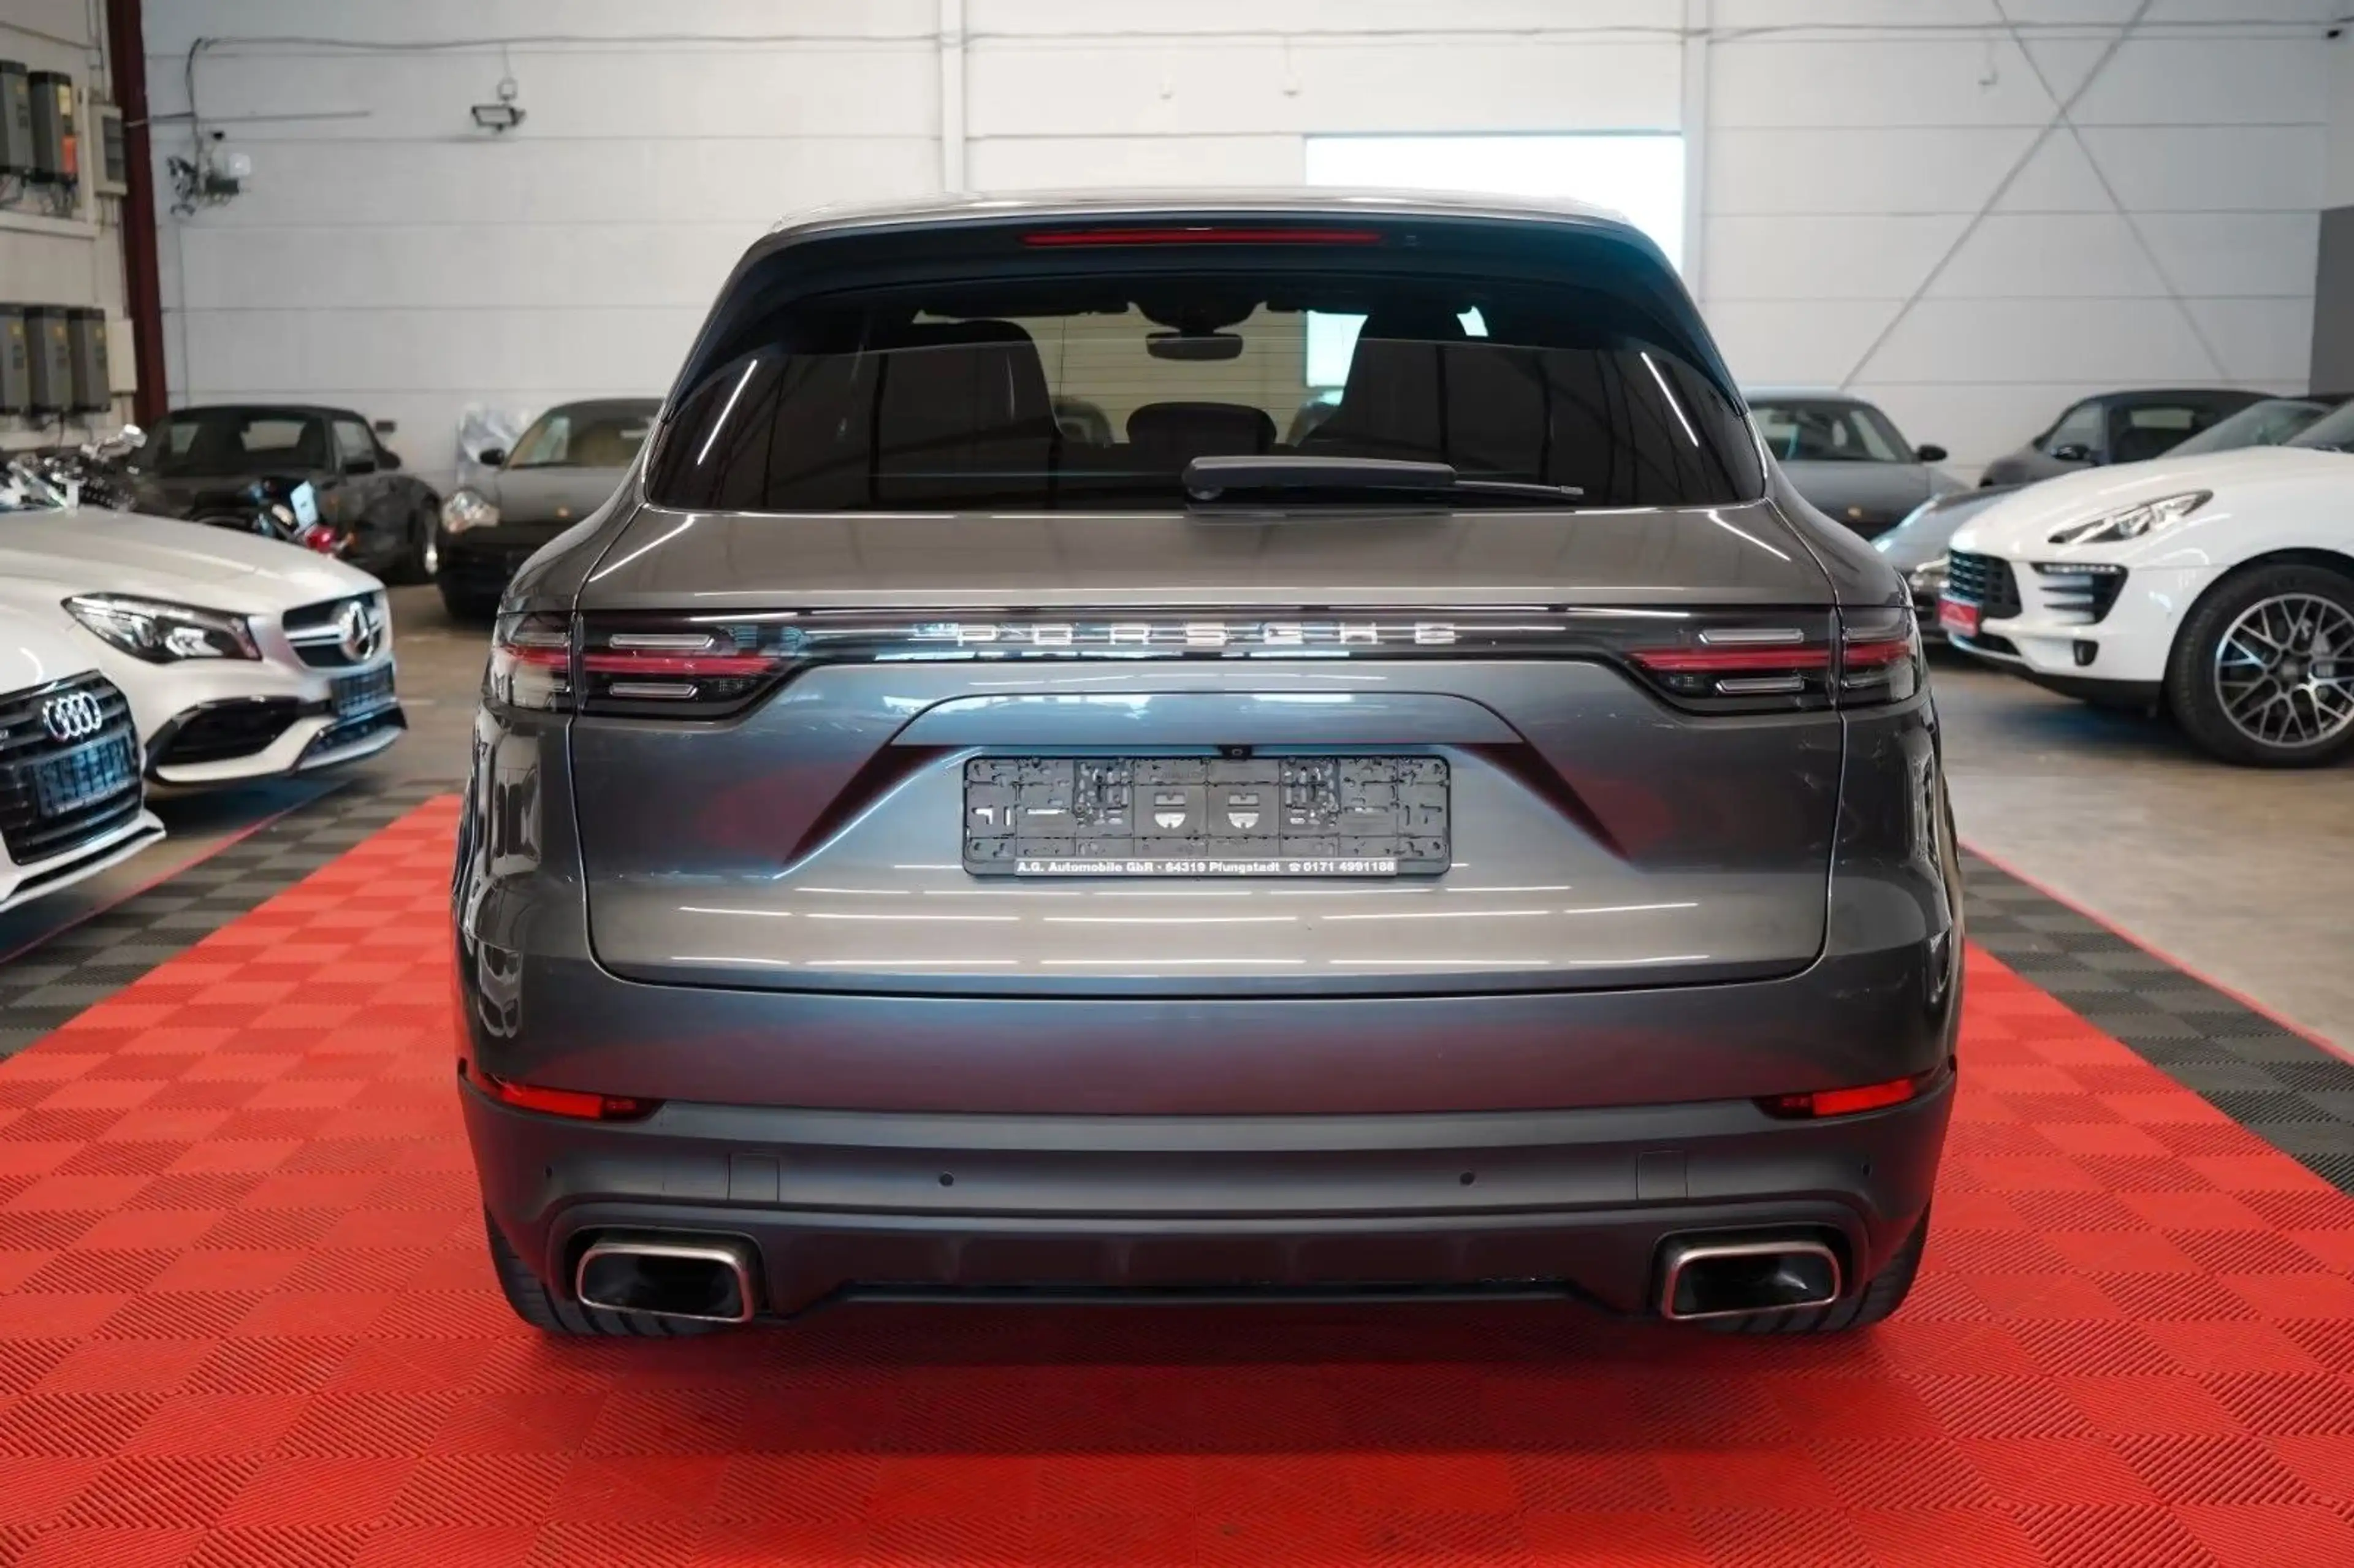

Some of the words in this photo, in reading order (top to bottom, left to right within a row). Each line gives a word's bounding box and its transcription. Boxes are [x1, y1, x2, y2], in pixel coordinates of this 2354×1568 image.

[957, 622, 1456, 646] PORSCHE
[1017, 861, 1043, 872] A.G.
[1048, 861, 1122, 872] Automobile
[1126, 861, 1153, 872] GbR
[1165, 861, 1206, 872] 64319
[1209, 861, 1280, 874] Pfungstadt
[1303, 861, 1334, 872] 0171
